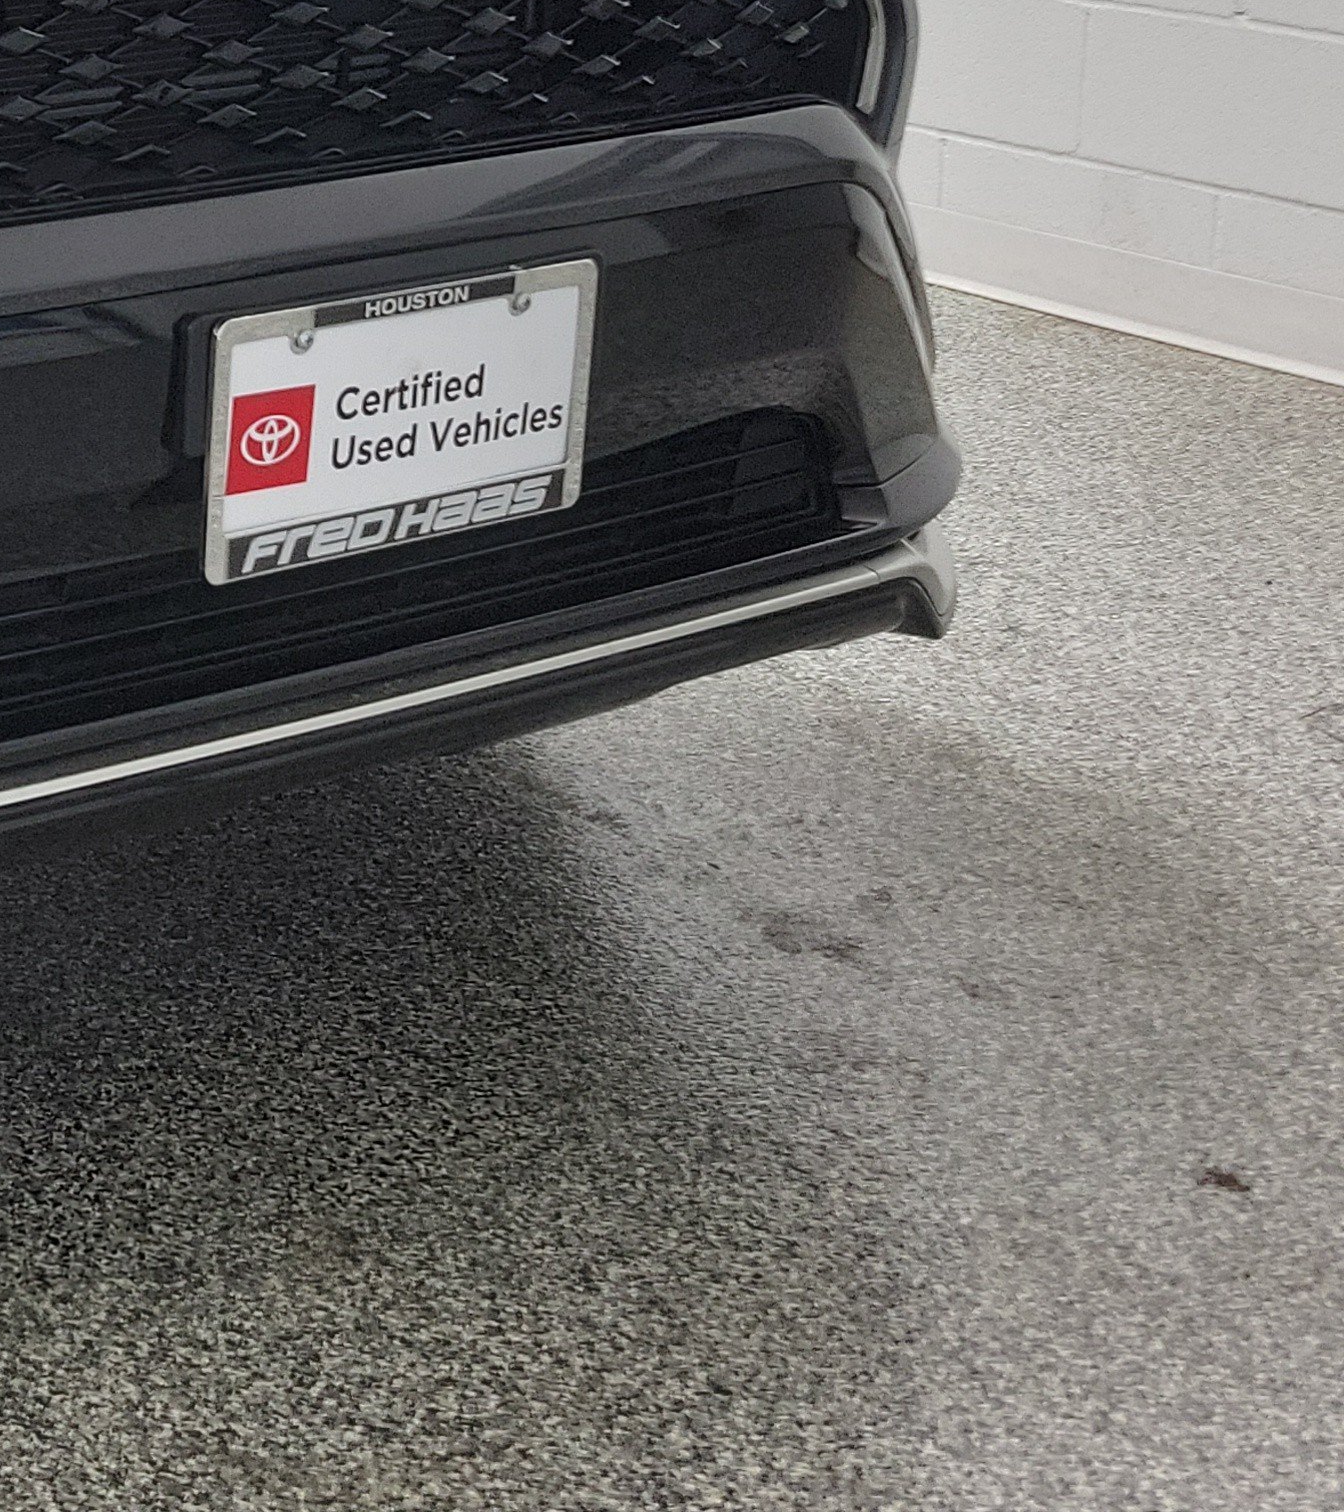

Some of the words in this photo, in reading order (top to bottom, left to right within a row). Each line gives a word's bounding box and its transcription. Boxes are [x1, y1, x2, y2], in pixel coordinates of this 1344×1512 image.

[364, 286, 470, 318] HOUSTON
[336, 364, 485, 420] Certified
[331, 424, 417, 469] Used
[430, 402, 564, 452] Vehicles
